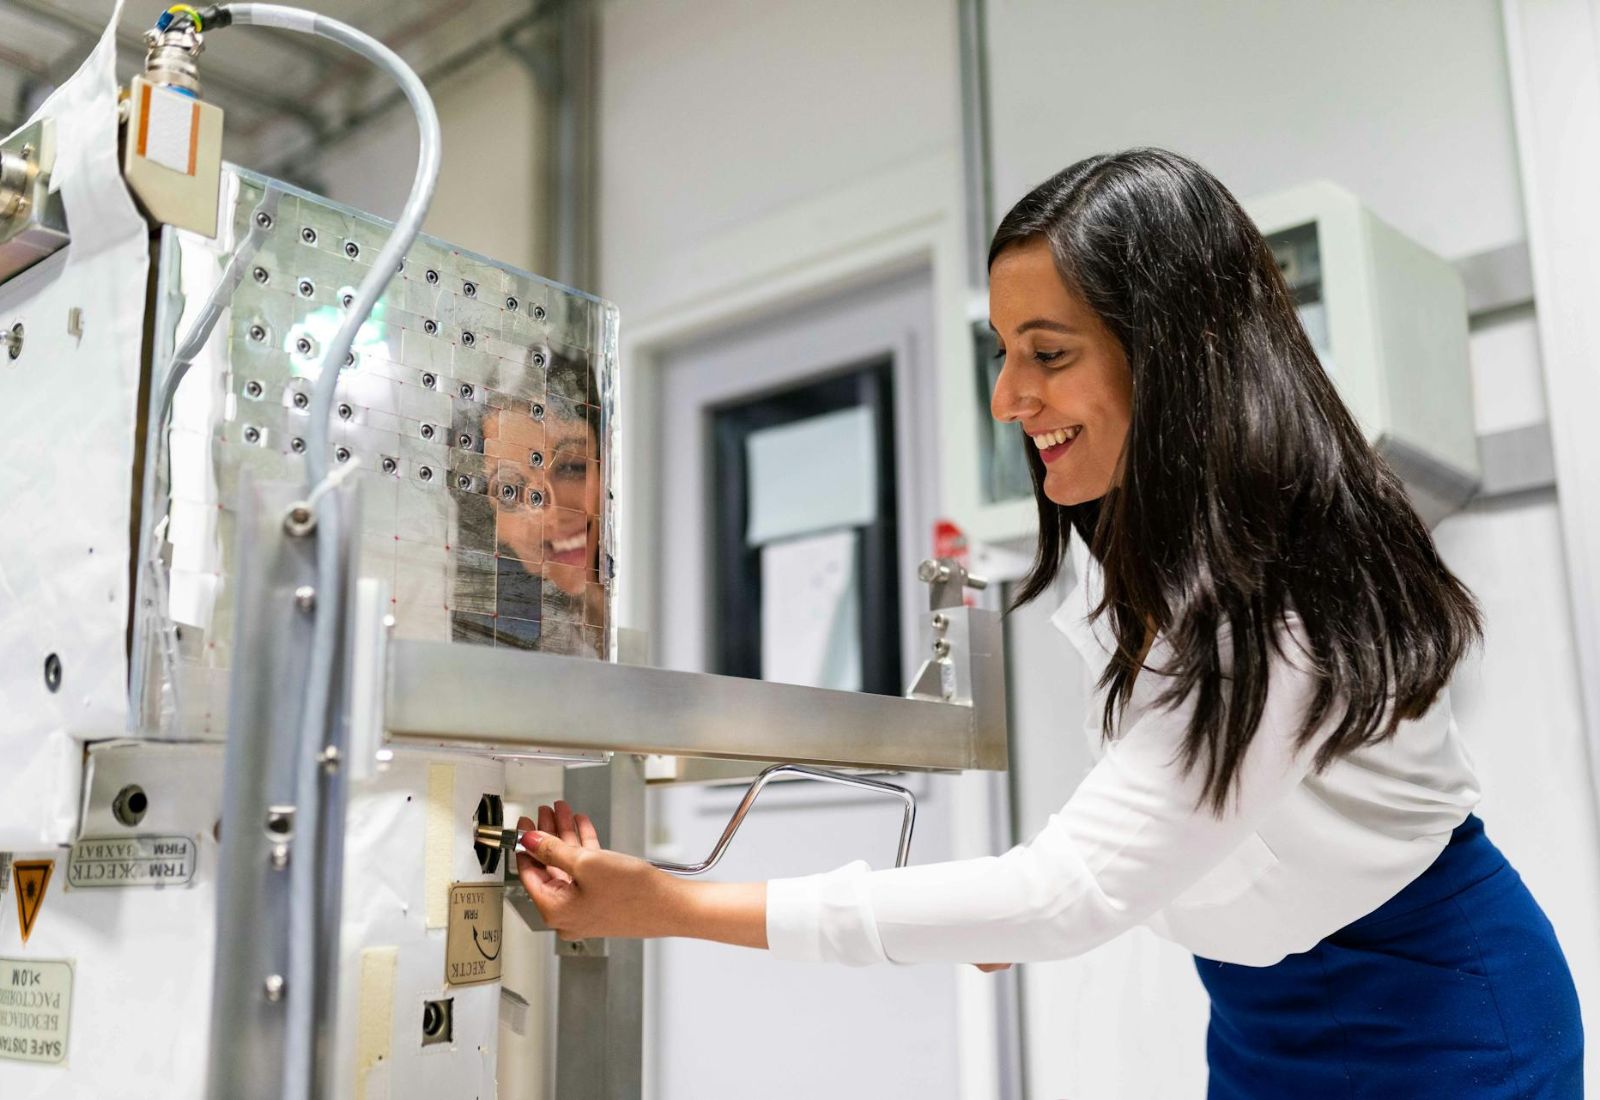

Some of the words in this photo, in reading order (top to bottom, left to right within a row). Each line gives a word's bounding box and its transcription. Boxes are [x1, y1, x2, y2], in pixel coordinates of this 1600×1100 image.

[153, 844, 187, 855] FIRM
[72, 863, 136, 880] ЖЕСТК
[149, 863, 186, 877] TRM
[451, 960, 486, 977] ЖЕСТК
[31, 1039, 62, 1057] SAFE
